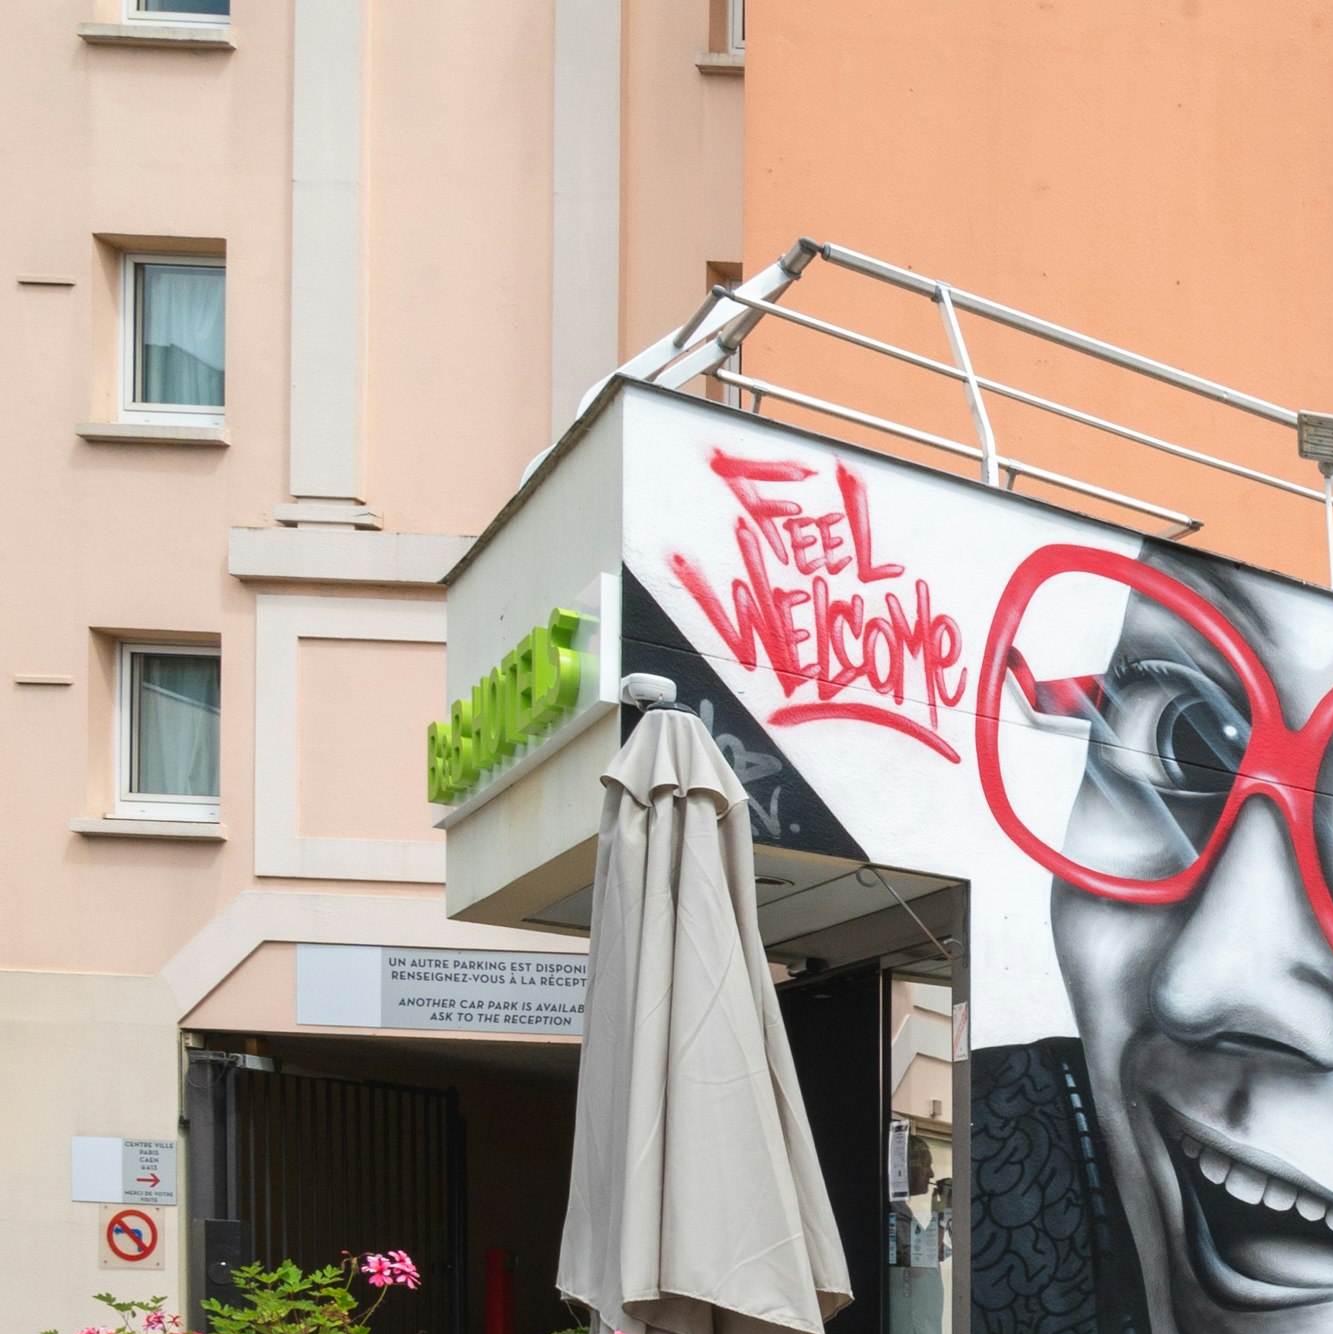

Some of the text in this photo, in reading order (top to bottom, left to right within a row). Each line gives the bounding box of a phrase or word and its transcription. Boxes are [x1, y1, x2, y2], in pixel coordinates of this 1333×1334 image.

[709, 449, 905, 584] FEEL
[388, 957, 587, 974] UN AUTRE PARKING EST DISPONI
[391, 970, 588, 987] RENSEIGNEZ-VOUS À LA RÉCEPT
[398, 998, 585, 1014] ANOTHER CAR PARK IS AVAILAB
[429, 1012, 572, 1026] ASK TO THE RECEPTION
